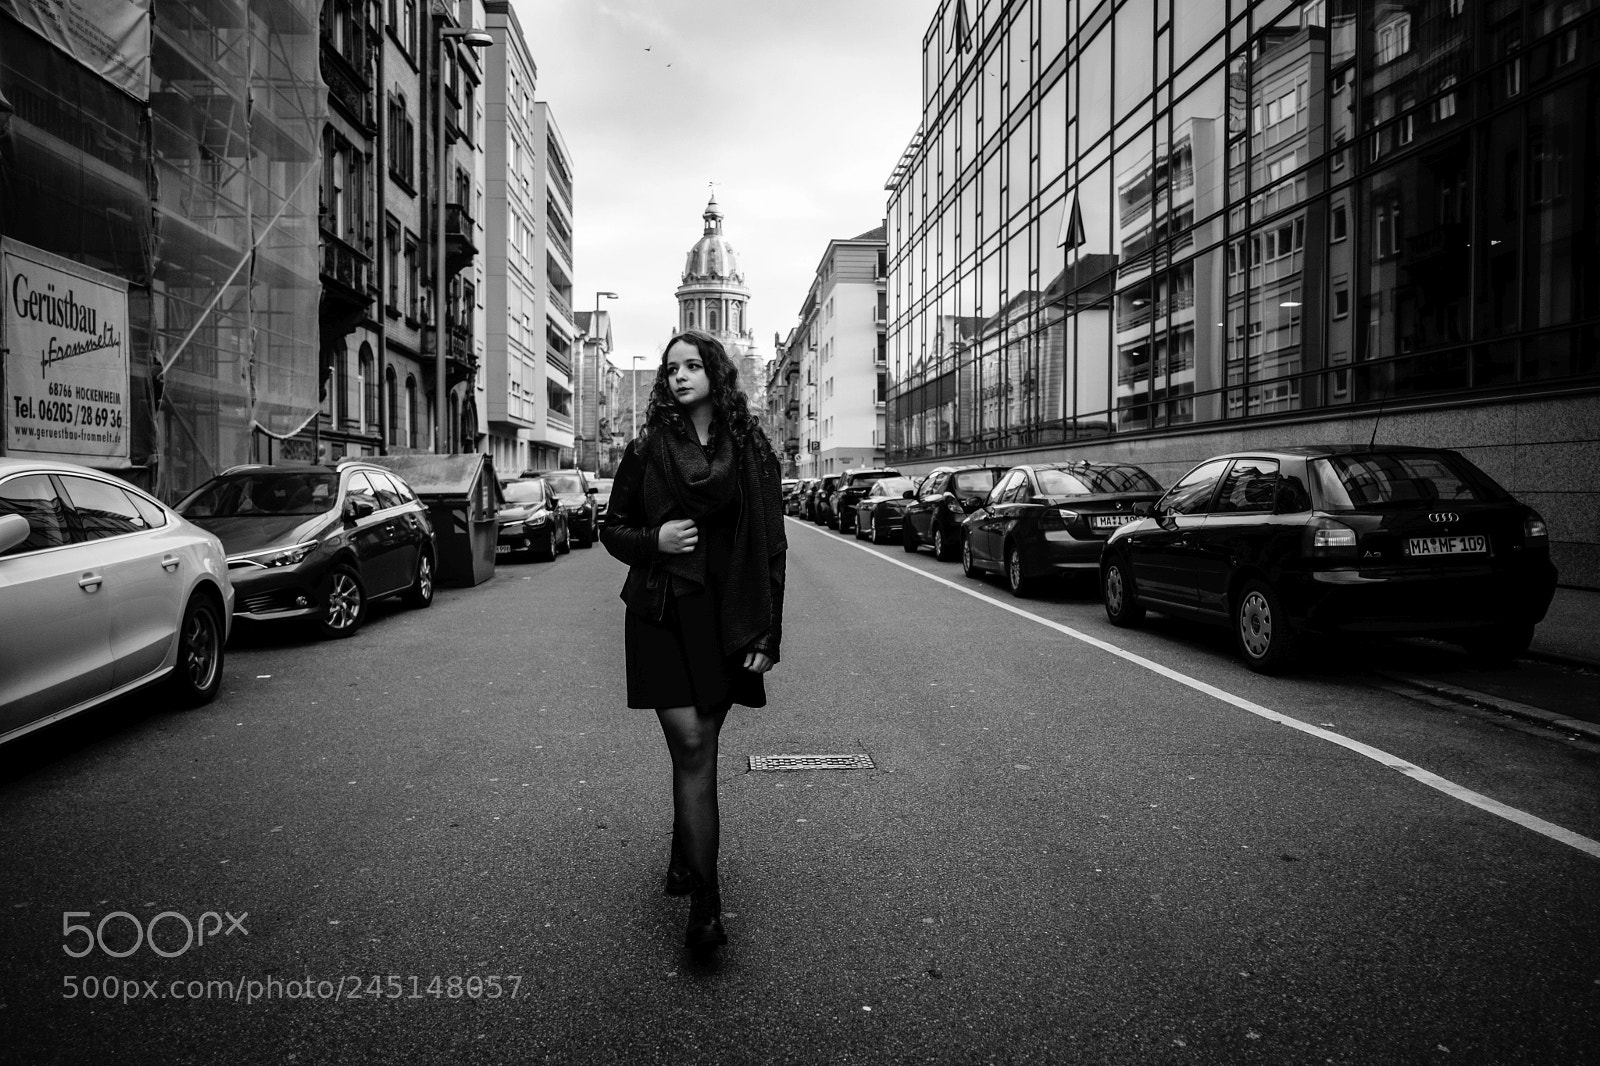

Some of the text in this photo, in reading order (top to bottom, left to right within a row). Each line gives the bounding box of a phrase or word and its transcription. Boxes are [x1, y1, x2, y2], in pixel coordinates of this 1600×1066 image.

[12, 273, 97, 336] Gerüstbau
[48, 382, 121, 405] 68766 HOCKENHEIM
[13, 395, 36, 419] Tel.
[14, 426, 121, 443] www.geruestbau-frommelt.de
[1100, 516, 1112, 526] MA
[1410, 537, 1485, 554] MA MF 109
